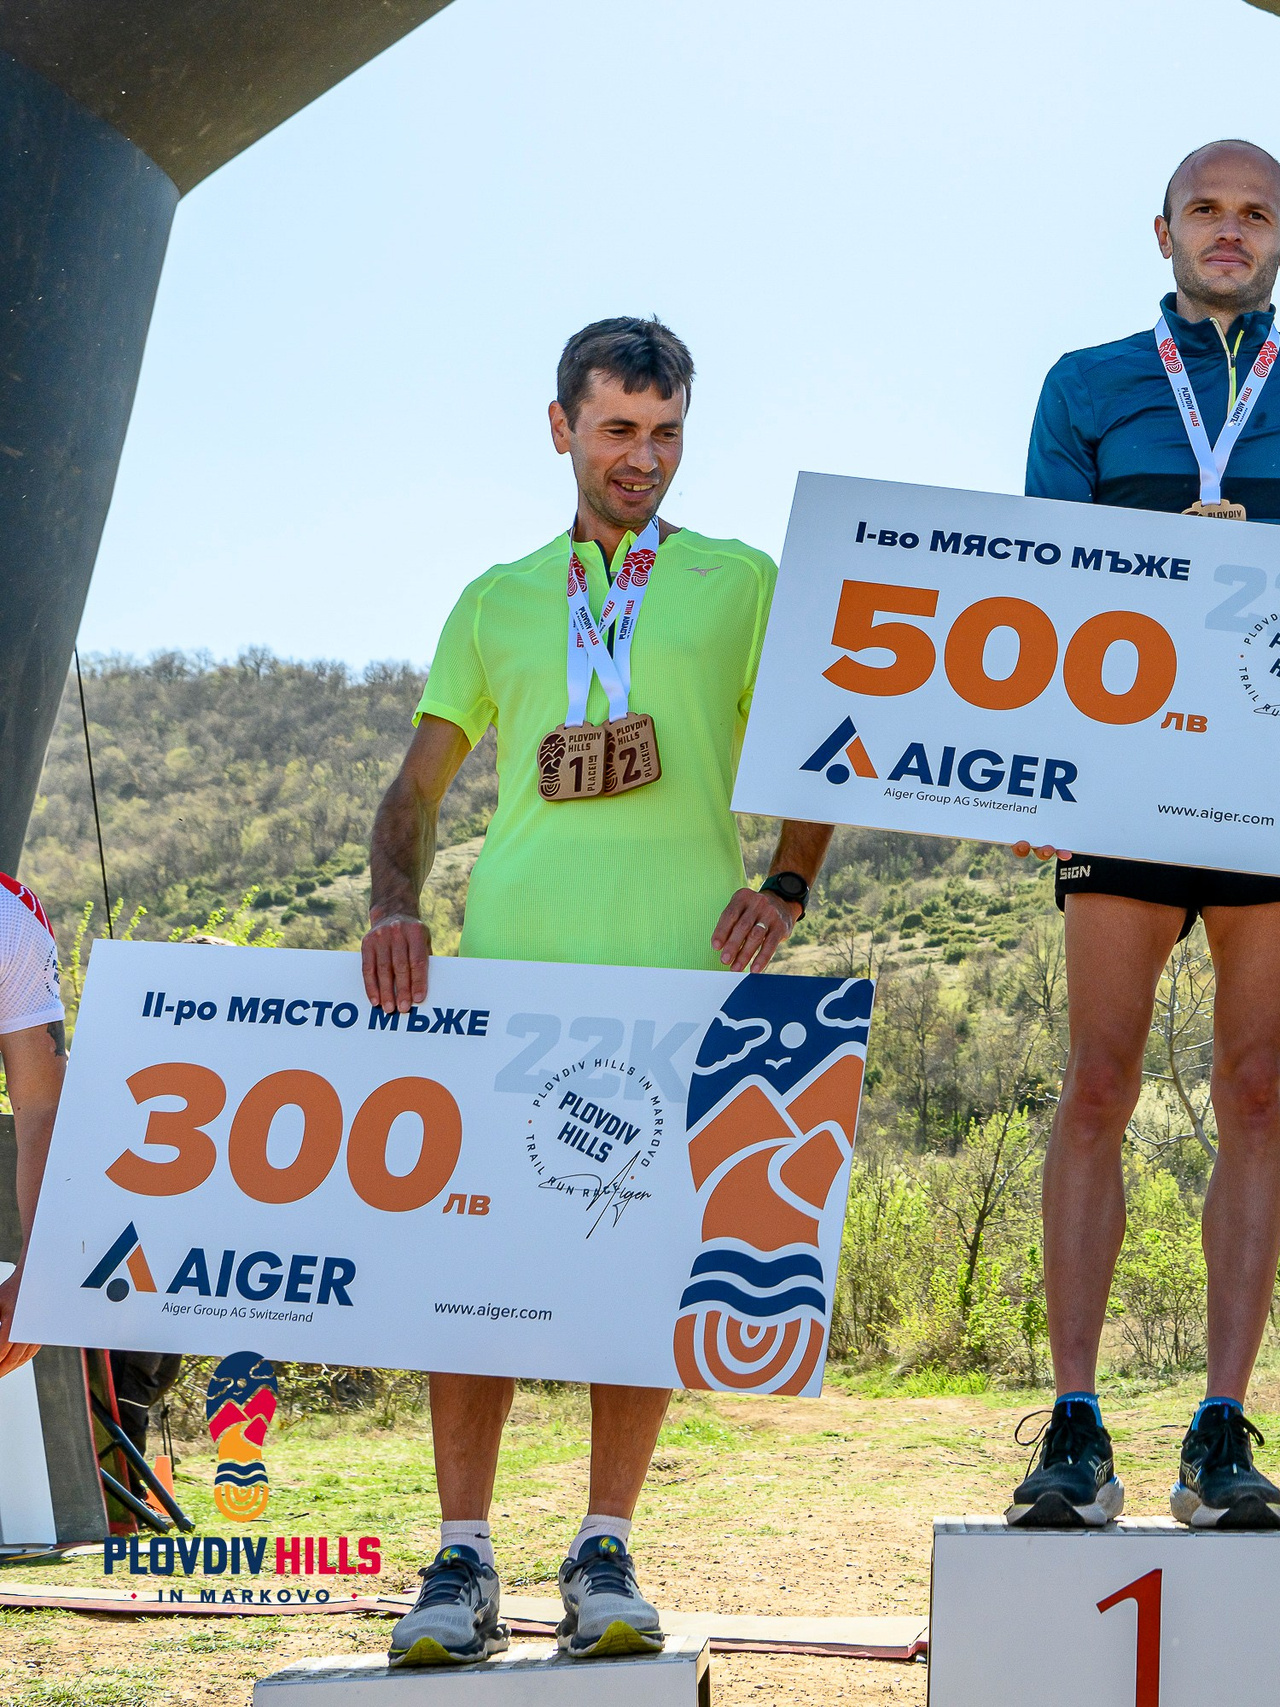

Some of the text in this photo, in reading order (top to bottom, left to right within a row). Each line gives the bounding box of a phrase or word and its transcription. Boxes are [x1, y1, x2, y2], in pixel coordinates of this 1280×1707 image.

[929, 529, 1062, 565] МЯСТО
[1071, 546, 1191, 581] МЪЖЕ
[821, 579, 1177, 725] 500
[1239, 667, 1259, 702] TRAIL
[568, 732, 602, 743] PLOVDIV
[616, 719, 648, 736] PLOVDIV
[618, 731, 640, 746] HILLS
[568, 743, 591, 753] HILLS
[618, 747, 641, 784] 2
[569, 756, 583, 792] 1
[887, 742, 1078, 803] AIGER
[884, 787, 1038, 814] Aiger Group AG Switzerland
[1157, 803, 1275, 827] www.aiger.com
[226, 996, 359, 1028] МЯСТО
[493, 1012, 700, 1103] 22K
[533, 1059, 664, 1167] PLOVDIV HILLS IN MARKOVO
[558, 1090, 641, 1145] PLOVDIV
[105, 1062, 462, 1212] 300
[525, 1134, 545, 1175] TRAIL
[557, 1121, 613, 1163] HILLS
[166, 1247, 356, 1306] AIGER
[161, 1302, 314, 1323] Aiger Group AG Switzerland
[433, 1302, 553, 1322] www.aiger.com
[1096, 1568, 1162, 1707] 1
